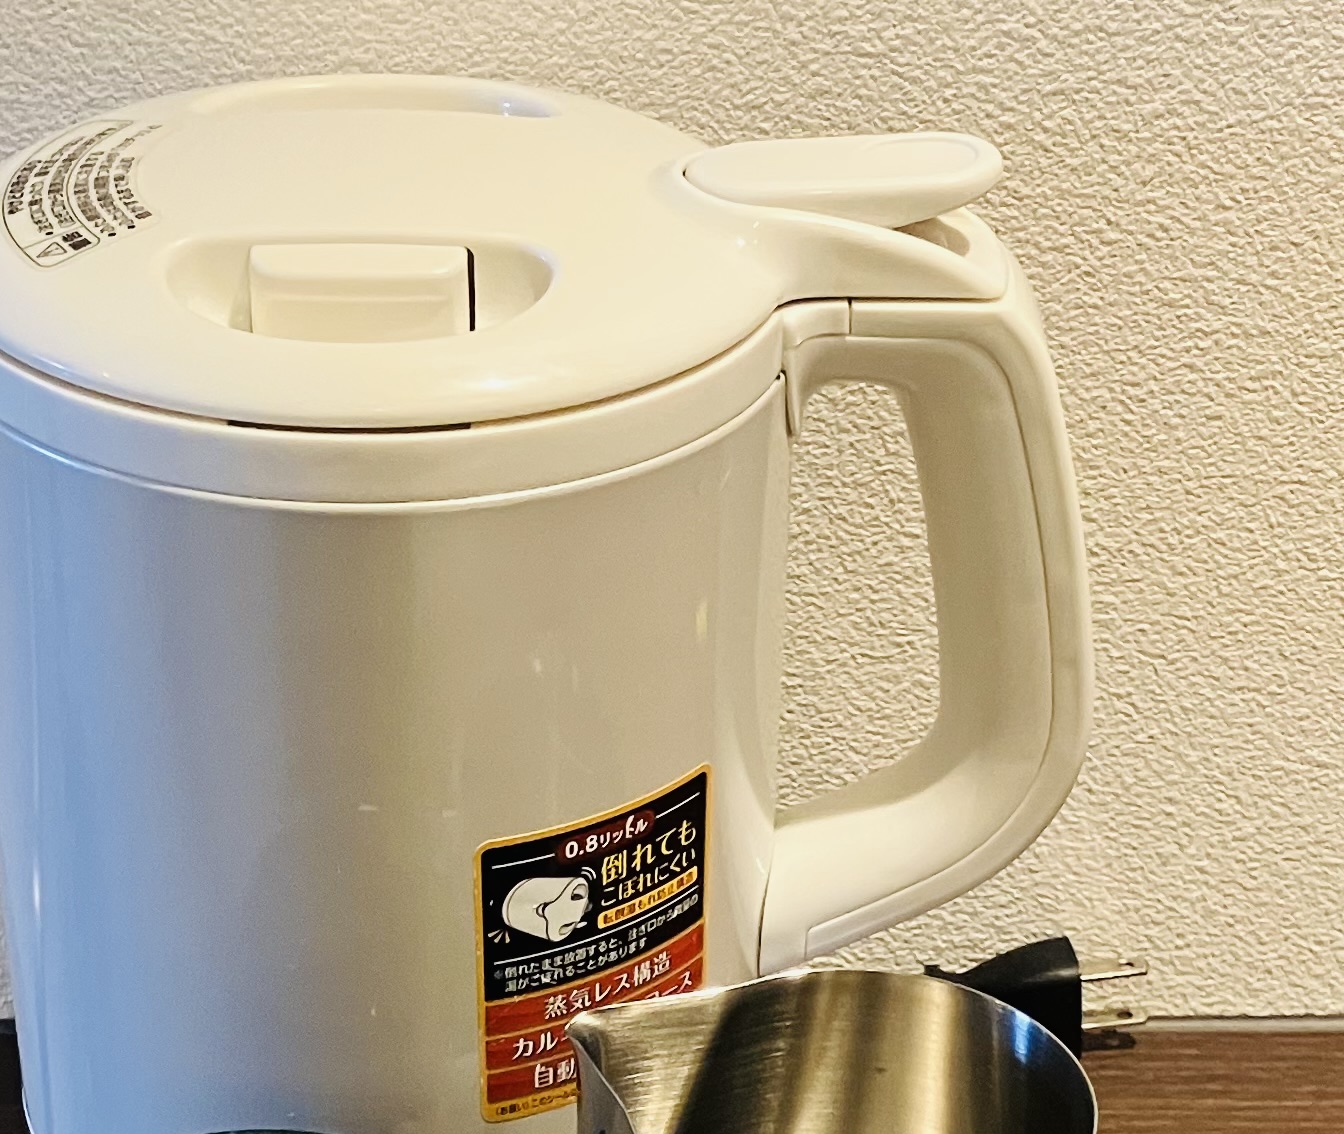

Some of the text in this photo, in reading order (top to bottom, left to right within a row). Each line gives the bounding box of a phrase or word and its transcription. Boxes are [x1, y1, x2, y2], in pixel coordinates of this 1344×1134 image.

[565, 815, 648, 858] 0.8リットル
[601, 820, 696, 886] 倒れても
[601, 848, 696, 907] こぼれにくい
[545, 953, 672, 1020] 蒸気レス構造
